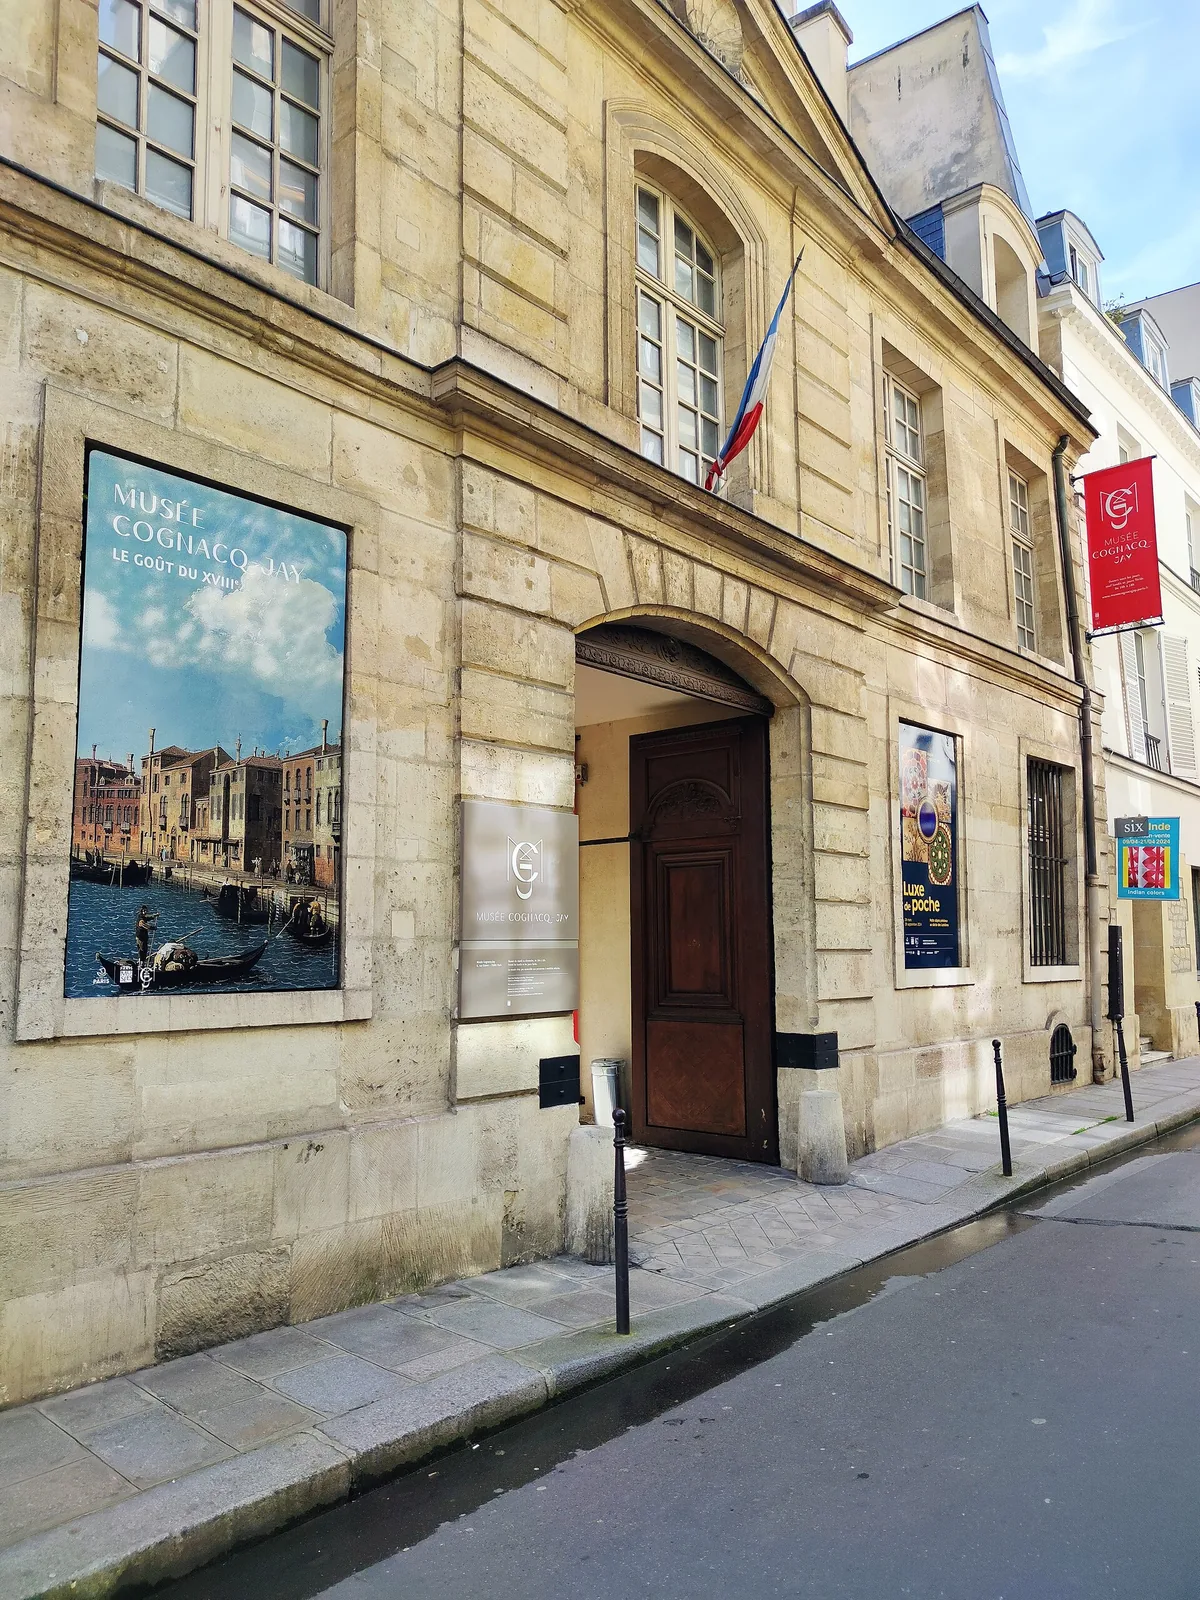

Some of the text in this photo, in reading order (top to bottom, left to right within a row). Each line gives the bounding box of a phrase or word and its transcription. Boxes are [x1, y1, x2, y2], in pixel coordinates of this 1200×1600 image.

[114, 484, 206, 529] MUSÉE
[1104, 531, 1138, 546] MUSÉE
[112, 548, 129, 562] LE
[134, 554, 174, 573] GOÛT
[178, 565, 197, 579] DU
[1114, 553, 1132, 564] JAY
[1124, 820, 1144, 832] six
[903, 881, 925, 896] Luxe
[904, 896, 940, 915] de poche
[476, 911, 504, 921] MUSÉE
